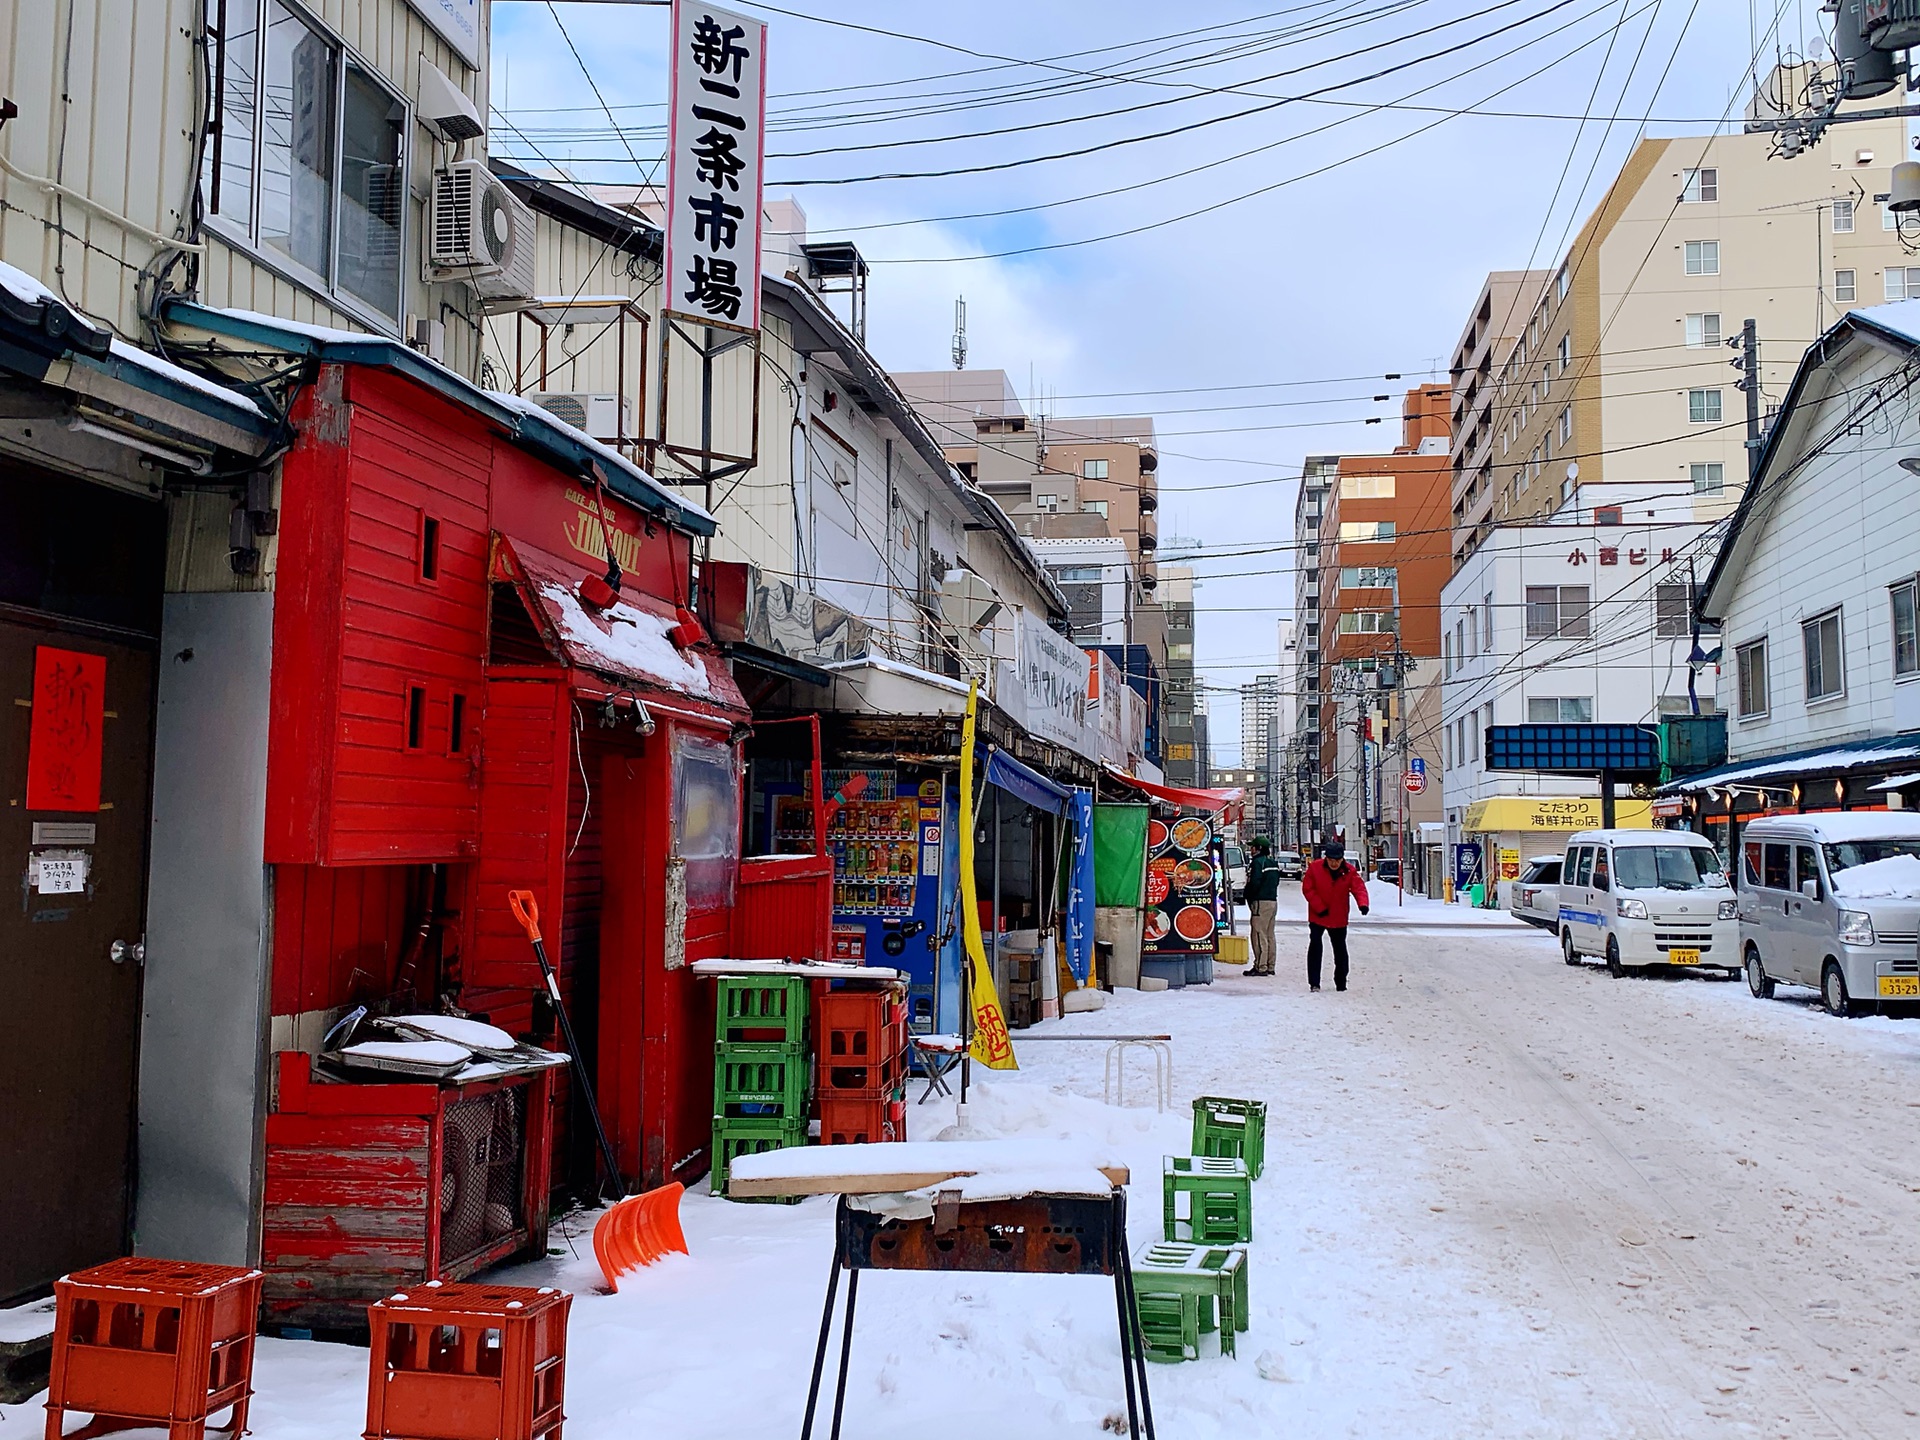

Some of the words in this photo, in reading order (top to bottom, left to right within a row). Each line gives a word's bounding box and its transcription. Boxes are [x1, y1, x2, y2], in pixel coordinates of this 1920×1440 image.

[684, 14, 750, 321] 新二条市場
[564, 488, 586, 508] CAFE
[1567, 547, 1678, 566] 小西ビル
[1539, 802, 1589, 813] こだわり
[1531, 815, 1599, 827] 海鮮丼の店
[1676, 955, 1699, 963] 44-03
[1889, 984, 1918, 995] 33-29
